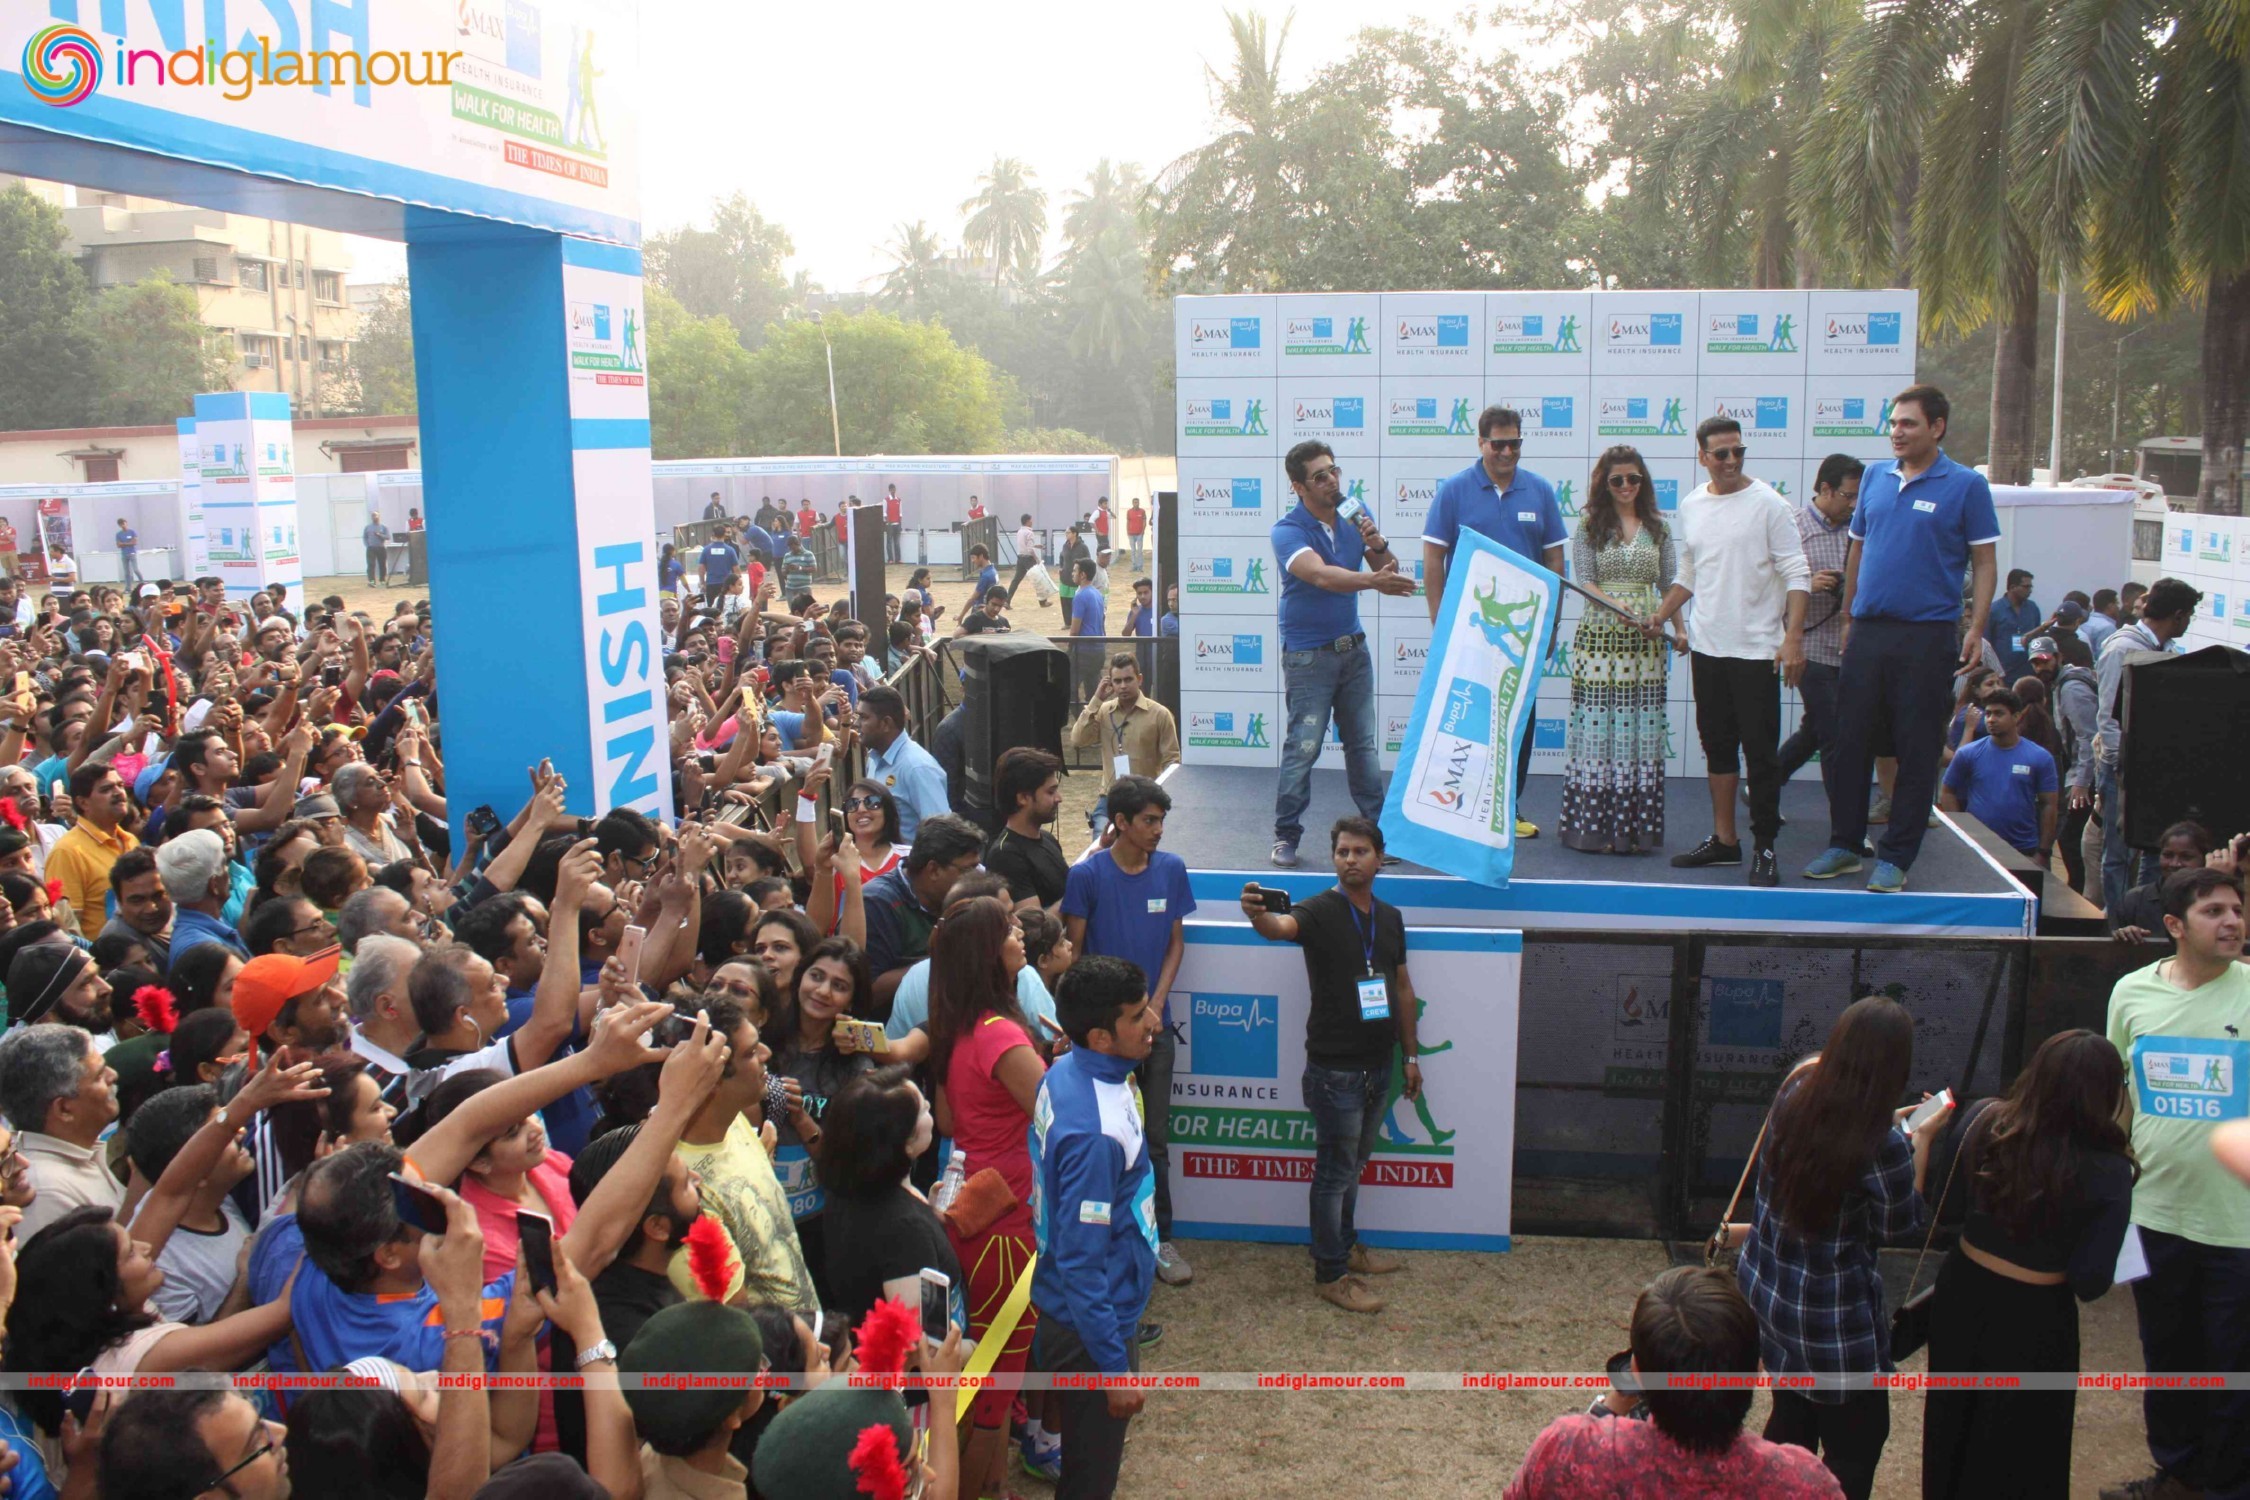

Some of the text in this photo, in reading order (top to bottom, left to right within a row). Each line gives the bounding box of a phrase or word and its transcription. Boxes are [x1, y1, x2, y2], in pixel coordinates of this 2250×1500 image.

[455, 58, 543, 100] HEALTH INSURANCE
[454, 90, 559, 138] WALK FOR HEALTH
[507, 145, 607, 185] THE TIMES OF INDIA
[579, 315, 594, 327] MAX
[1203, 329, 1230, 339] MAX
[1409, 327, 1436, 337] MAX
[1621, 325, 1648, 335] MAX
[1838, 325, 1866, 335] MAX
[573, 355, 620, 368] WALK FOR HEALTH
[1306, 409, 1332, 418] MAX
[1728, 408, 1754, 418] MAX
[1205, 489, 1231, 498] MAX
[1409, 489, 1434, 499] MAX
[1207, 644, 1232, 654] MAX
[594, 541, 661, 818] NISH
[1443, 701, 1473, 792] MAX Bupa
[1495, 671, 1518, 829] WALK FOR HEALTH
[1714, 983, 1754, 999] Bupa
[1195, 999, 1243, 1019] Bupa
[1365, 1007, 1387, 1017] CREW
[1613, 1048, 1663, 1060] HEALT
[1173, 1083, 1278, 1099] NSURANCE
[2154, 1096, 2221, 1117] 01516
[1169, 1114, 1317, 1141] OR HEALTH
[1190, 1156, 1240, 1176] THE
[1375, 1164, 1446, 1185] INDIA
